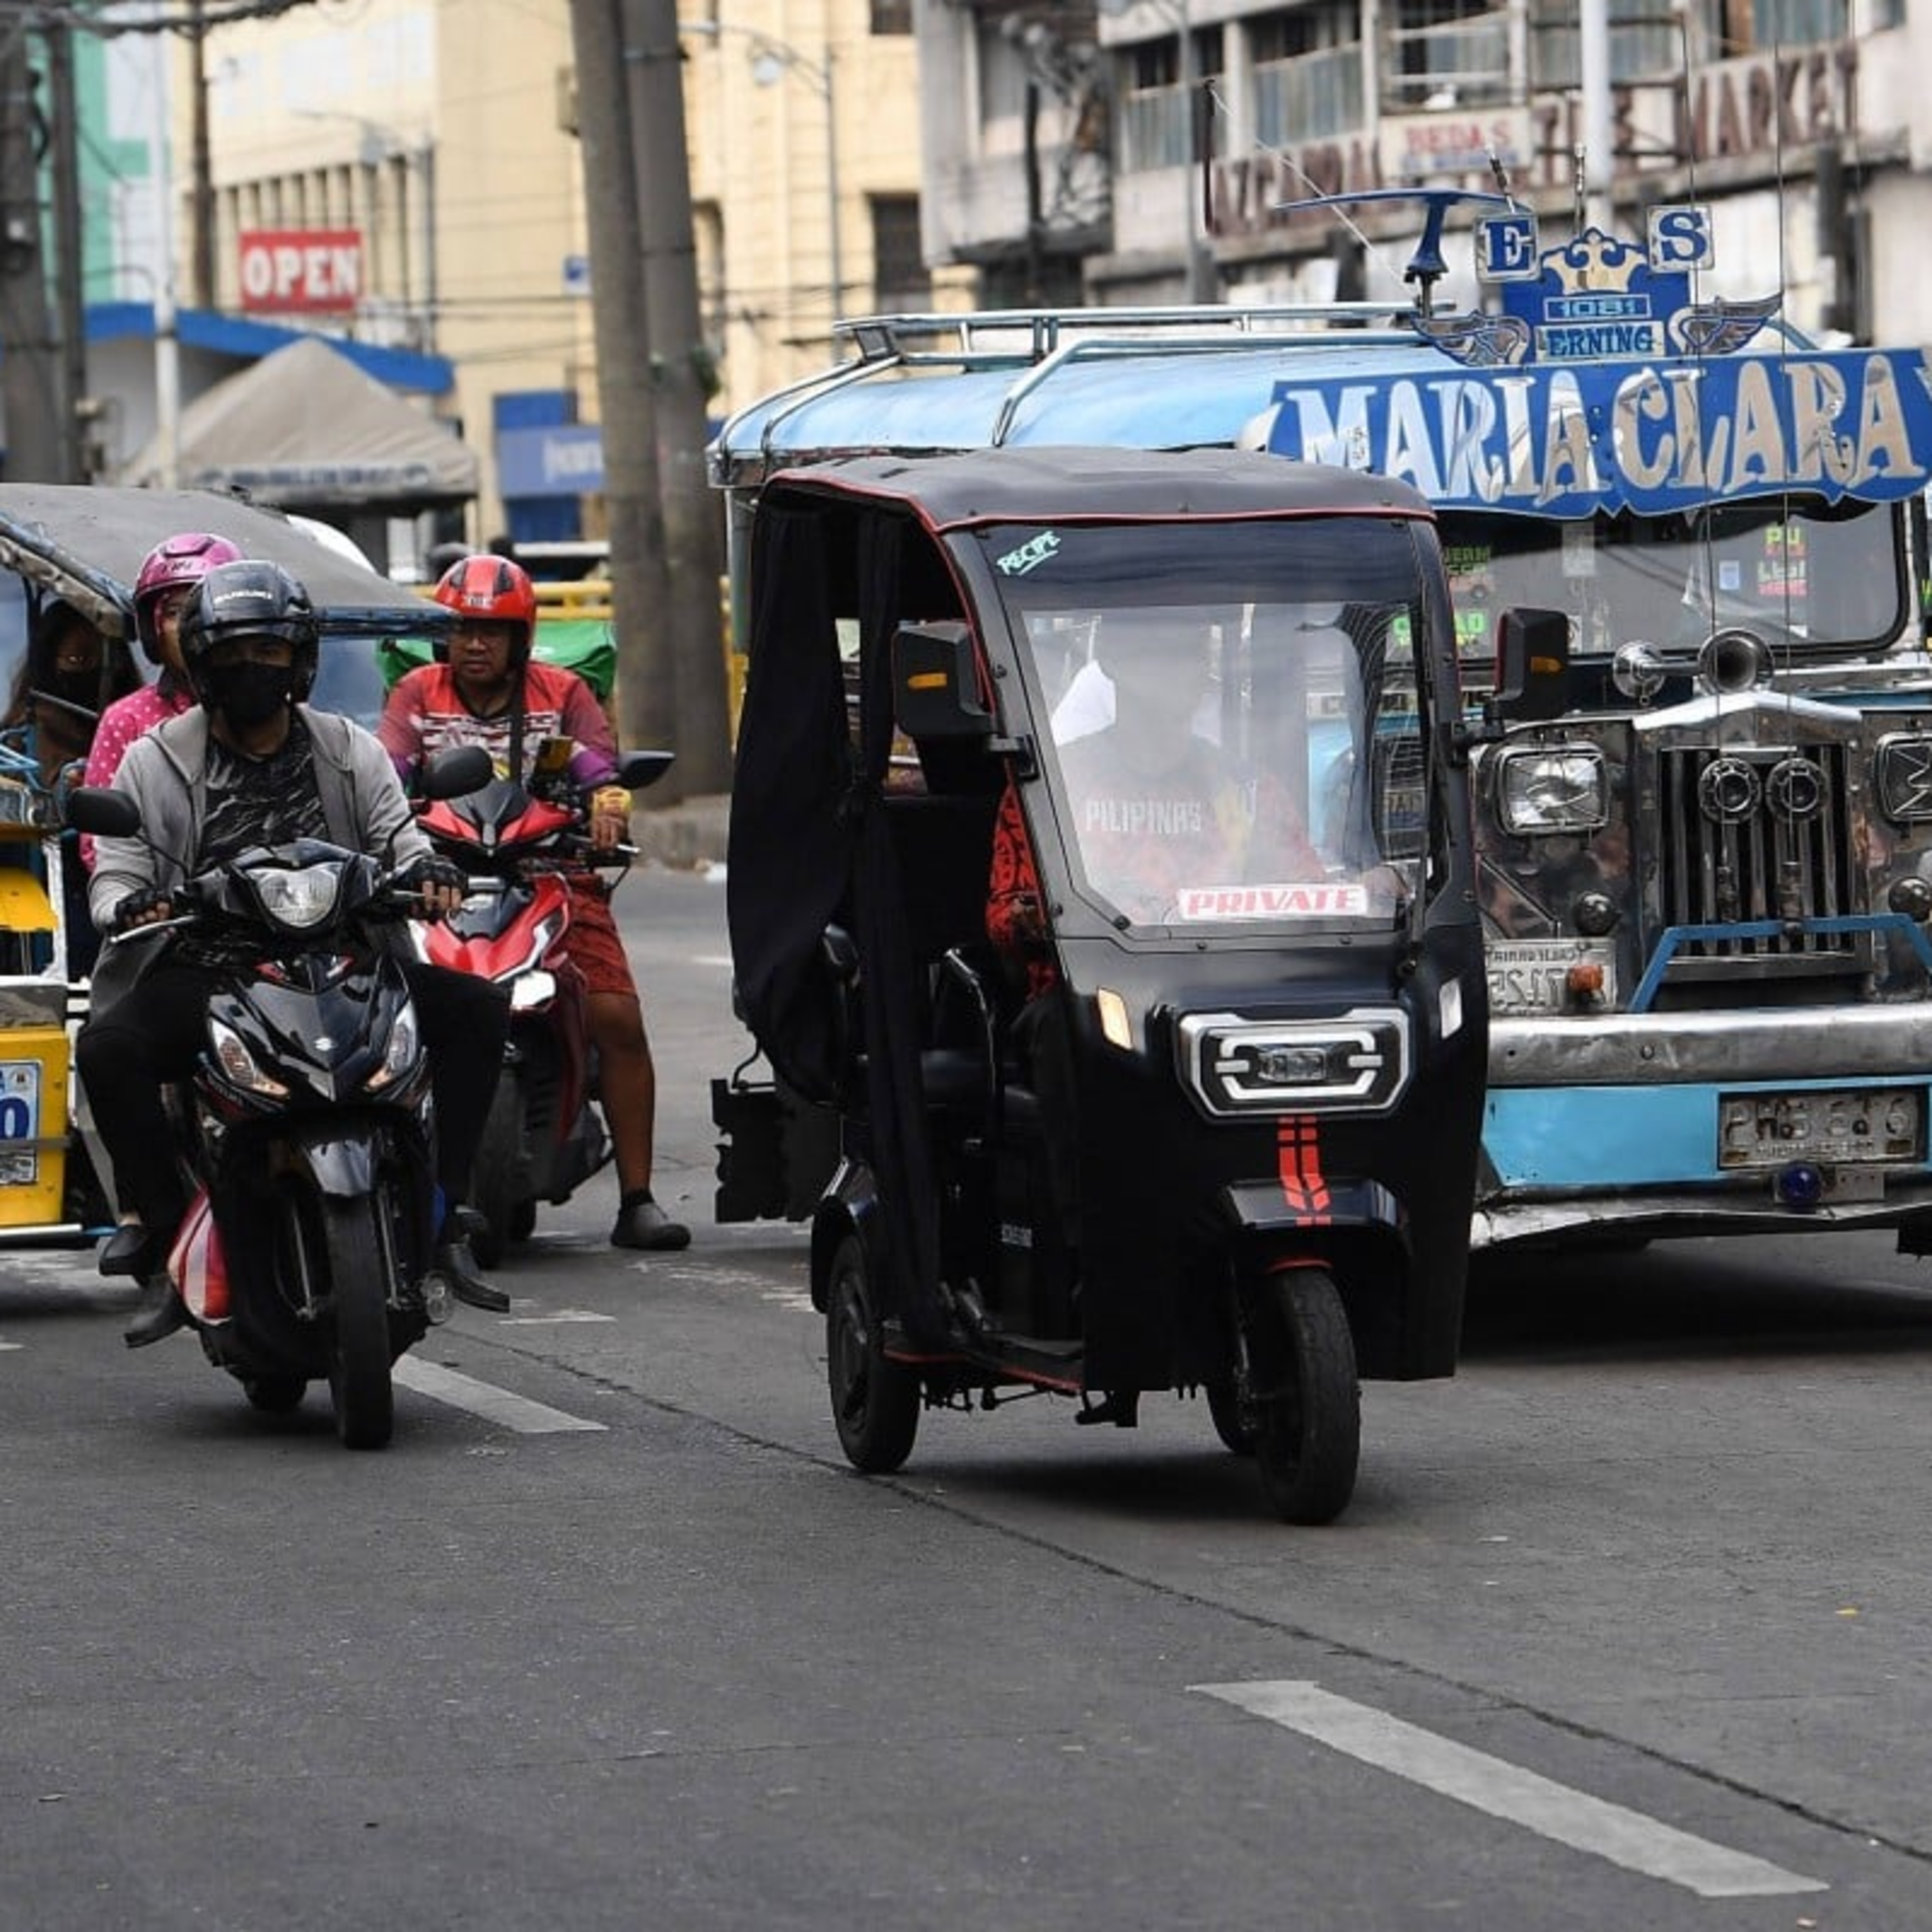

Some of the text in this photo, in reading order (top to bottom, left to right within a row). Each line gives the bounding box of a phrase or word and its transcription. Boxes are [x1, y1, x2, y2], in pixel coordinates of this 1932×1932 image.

[1678, 40, 1858, 159] MARKET
[1485, 220, 1531, 270] E
[1658, 211, 1706, 261] S
[245, 246, 358, 298] OPEN
[1549, 325, 1653, 356] ERNING
[1287, 354, 1927, 507] MARIA CLARA
[997, 531, 1061, 575] RECIPE
[1085, 799, 1202, 834] PILIPINAS
[1188, 888, 1360, 916] PRIVATE
